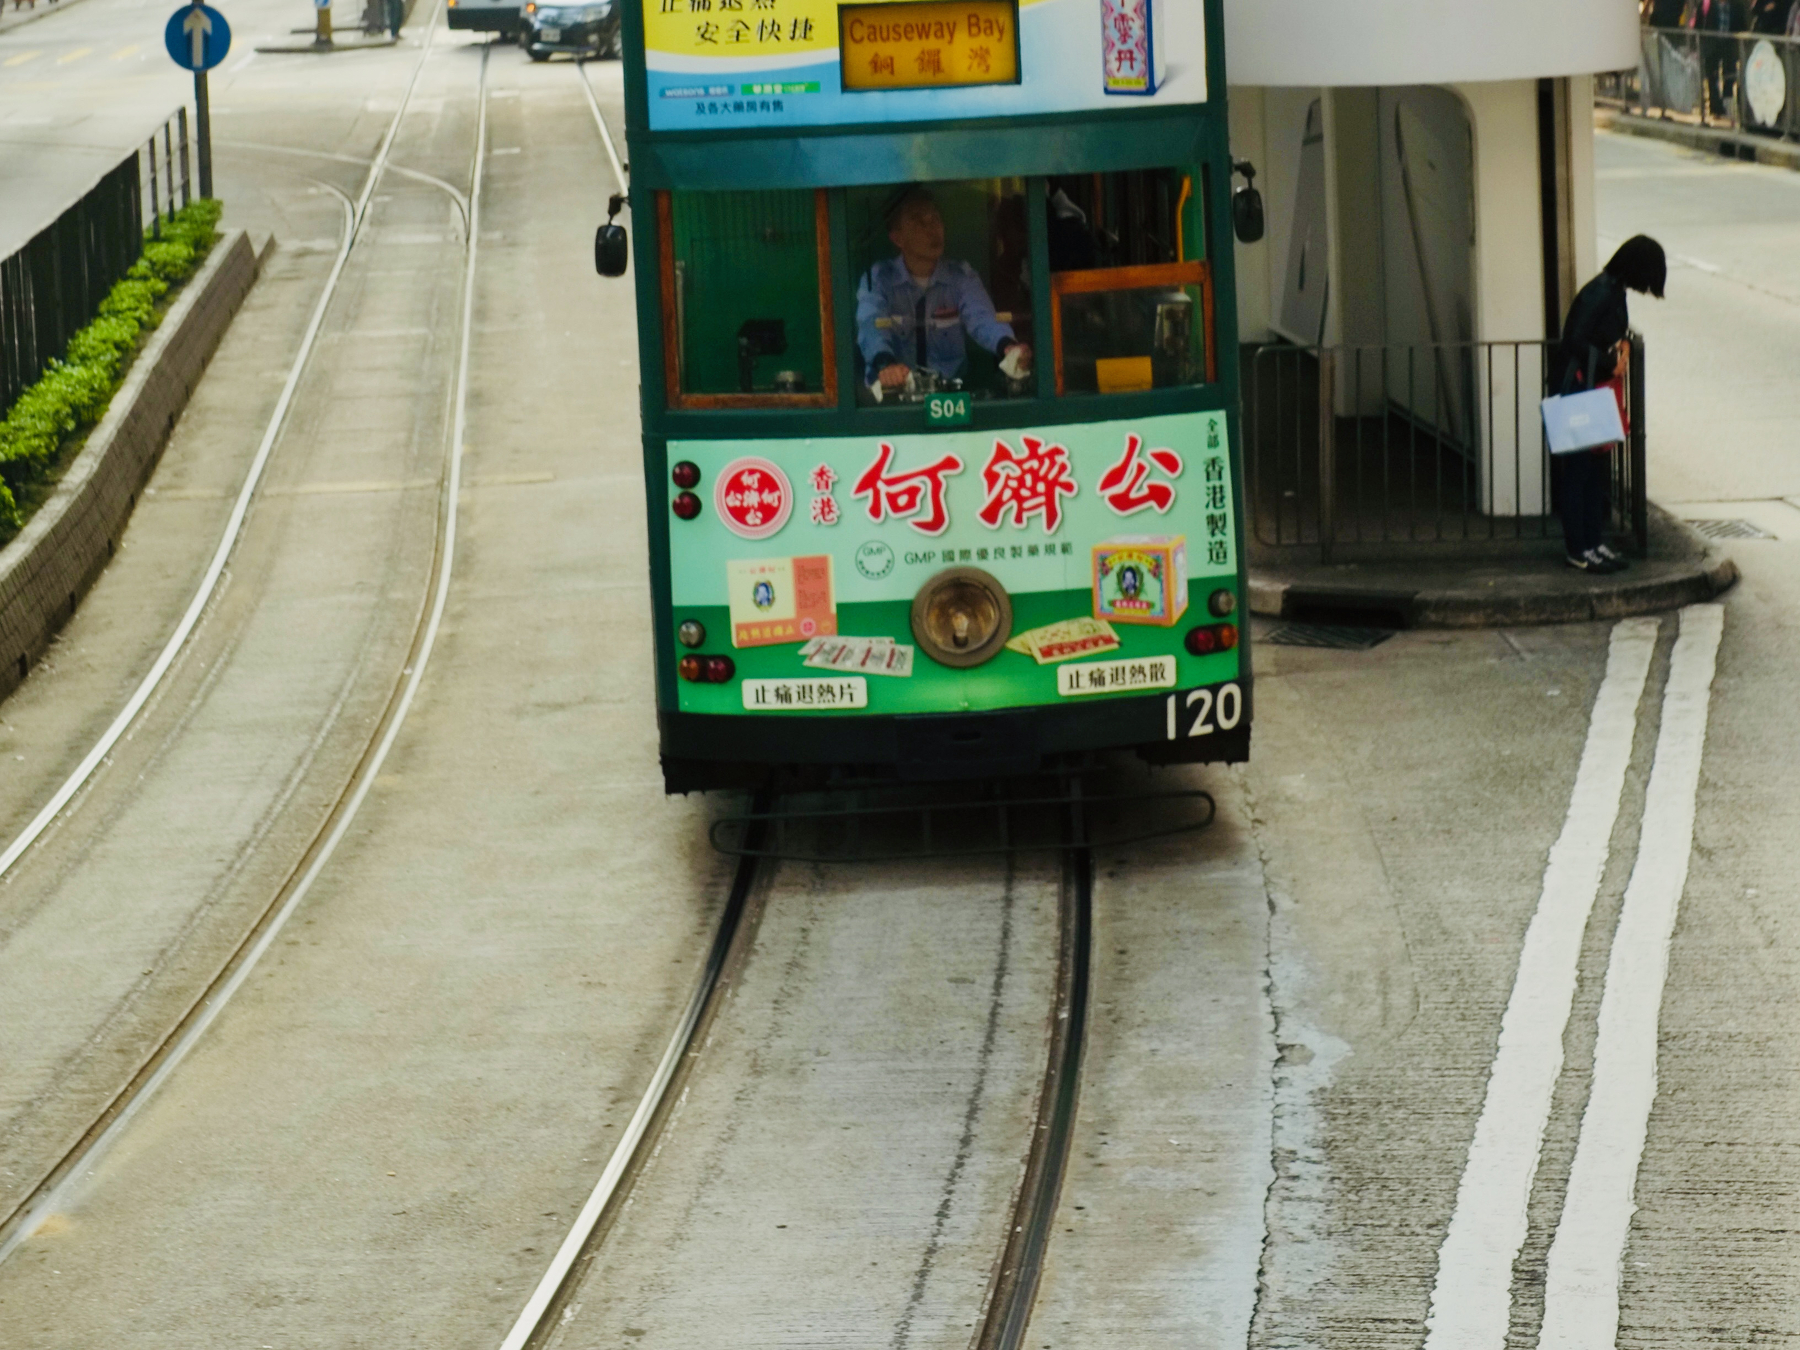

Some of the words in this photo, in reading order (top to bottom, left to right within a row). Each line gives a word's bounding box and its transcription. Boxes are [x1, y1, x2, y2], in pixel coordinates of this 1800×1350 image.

[694, 16, 815, 46] 安全快捷
[850, 17, 957, 45] Causeway
[967, 13, 1006, 43] Bay
[868, 45, 991, 77] 銅鑼灣
[930, 398, 966, 420] S04
[809, 462, 840, 526] 香港
[851, 433, 1183, 536] 何濟公
[863, 546, 886, 557] GMP
[904, 550, 936, 565] GMP
[1068, 662, 1167, 691] 止痛退熱散
[754, 683, 857, 706] 止痛退熱片
[1166, 682, 1242, 741] 120
